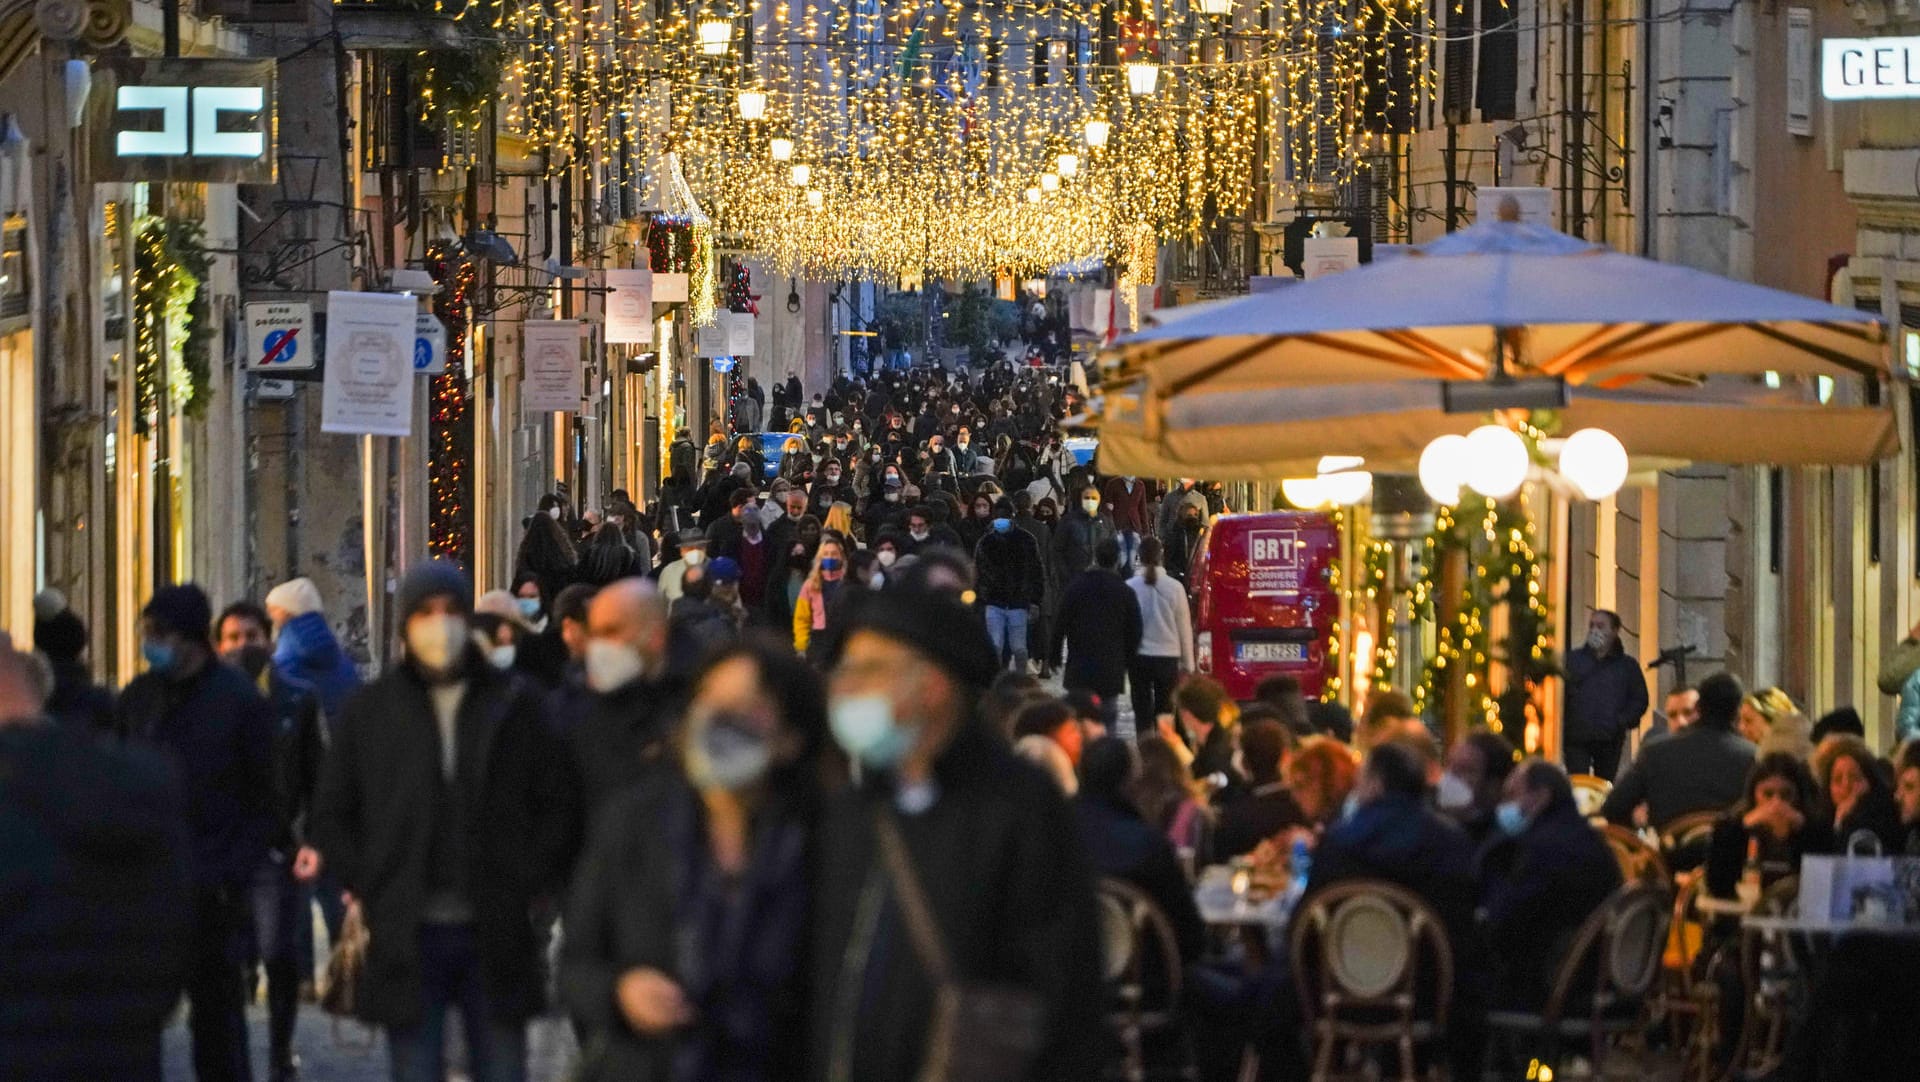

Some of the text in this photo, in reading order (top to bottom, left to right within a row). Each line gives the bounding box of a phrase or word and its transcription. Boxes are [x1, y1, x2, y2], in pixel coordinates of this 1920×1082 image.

[1841, 48, 1920, 86] GEL
[1253, 538, 1293, 560] BRT
[1249, 571, 1298, 580] CORRIERE
[1249, 580, 1299, 589] ESPRESSO
